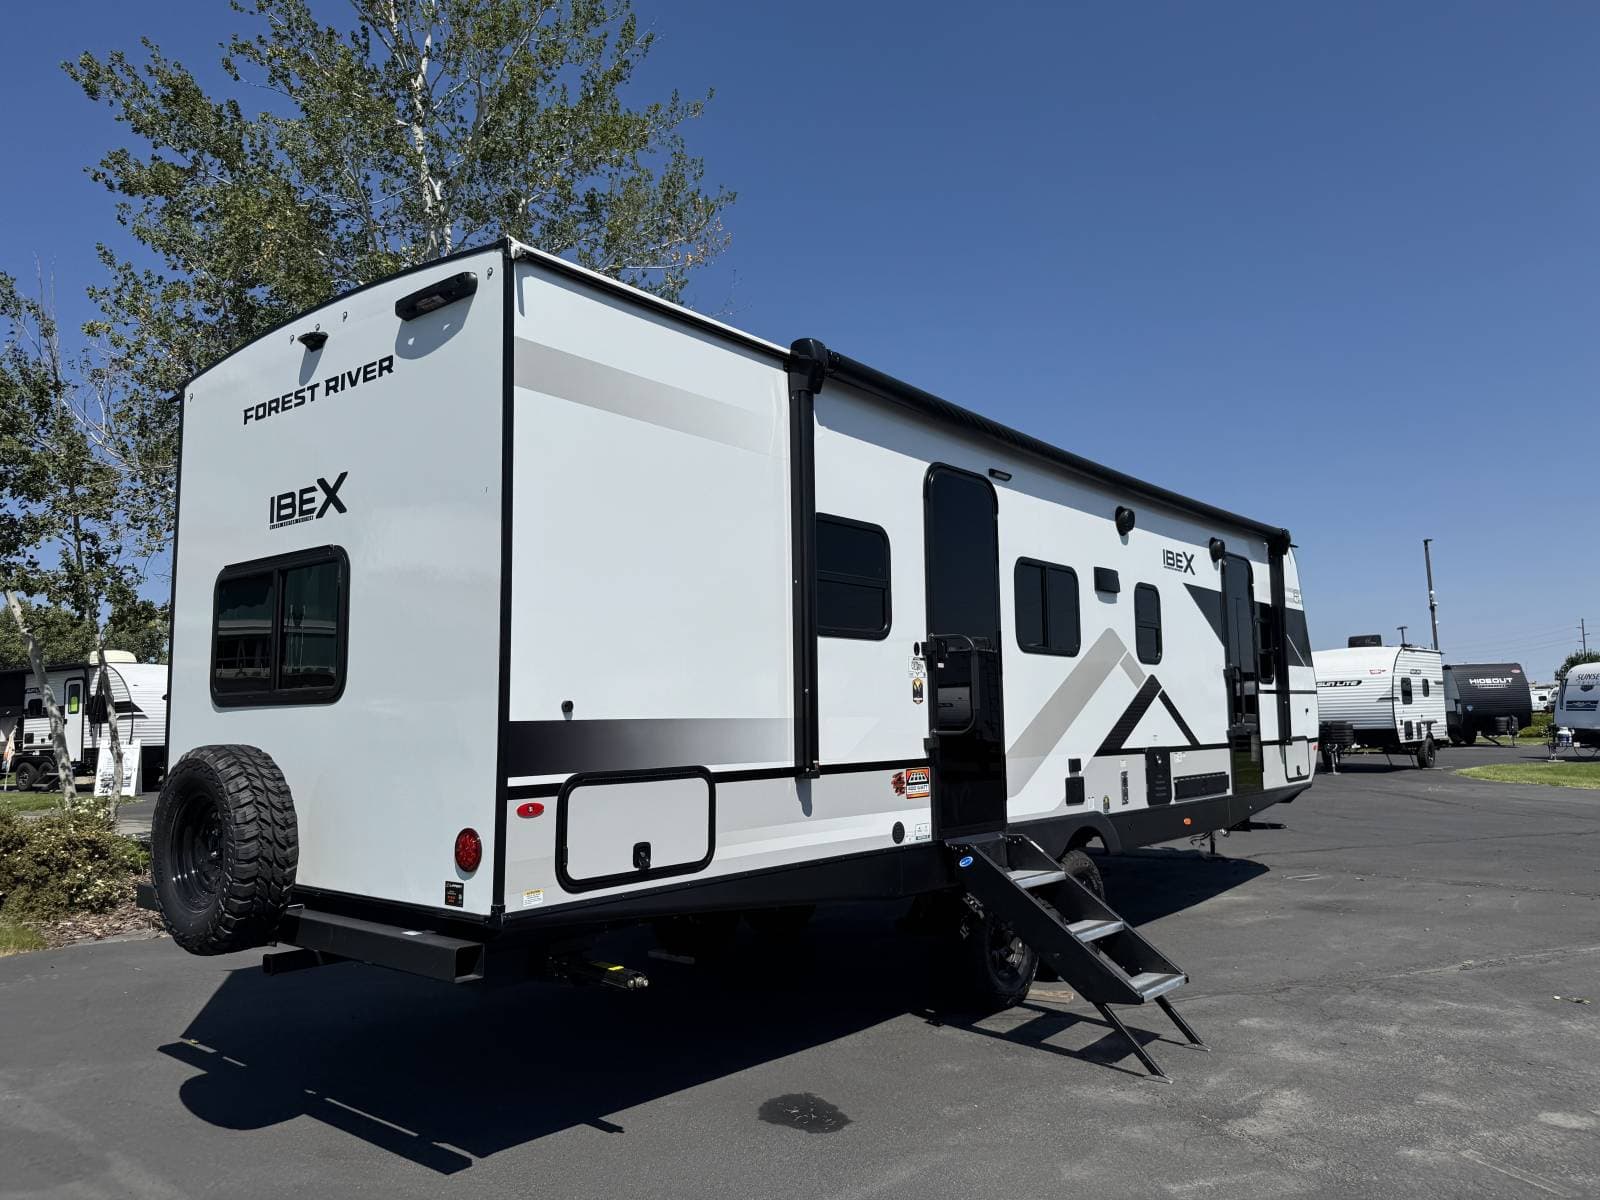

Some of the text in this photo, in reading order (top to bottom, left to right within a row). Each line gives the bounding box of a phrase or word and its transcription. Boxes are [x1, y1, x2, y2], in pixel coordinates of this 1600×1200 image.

[243, 354, 394, 425] FOREST RIVER
[270, 471, 348, 523] IBEX
[1163, 549, 1196, 576] IBEX
[1469, 677, 1513, 685] HIDEOUT
